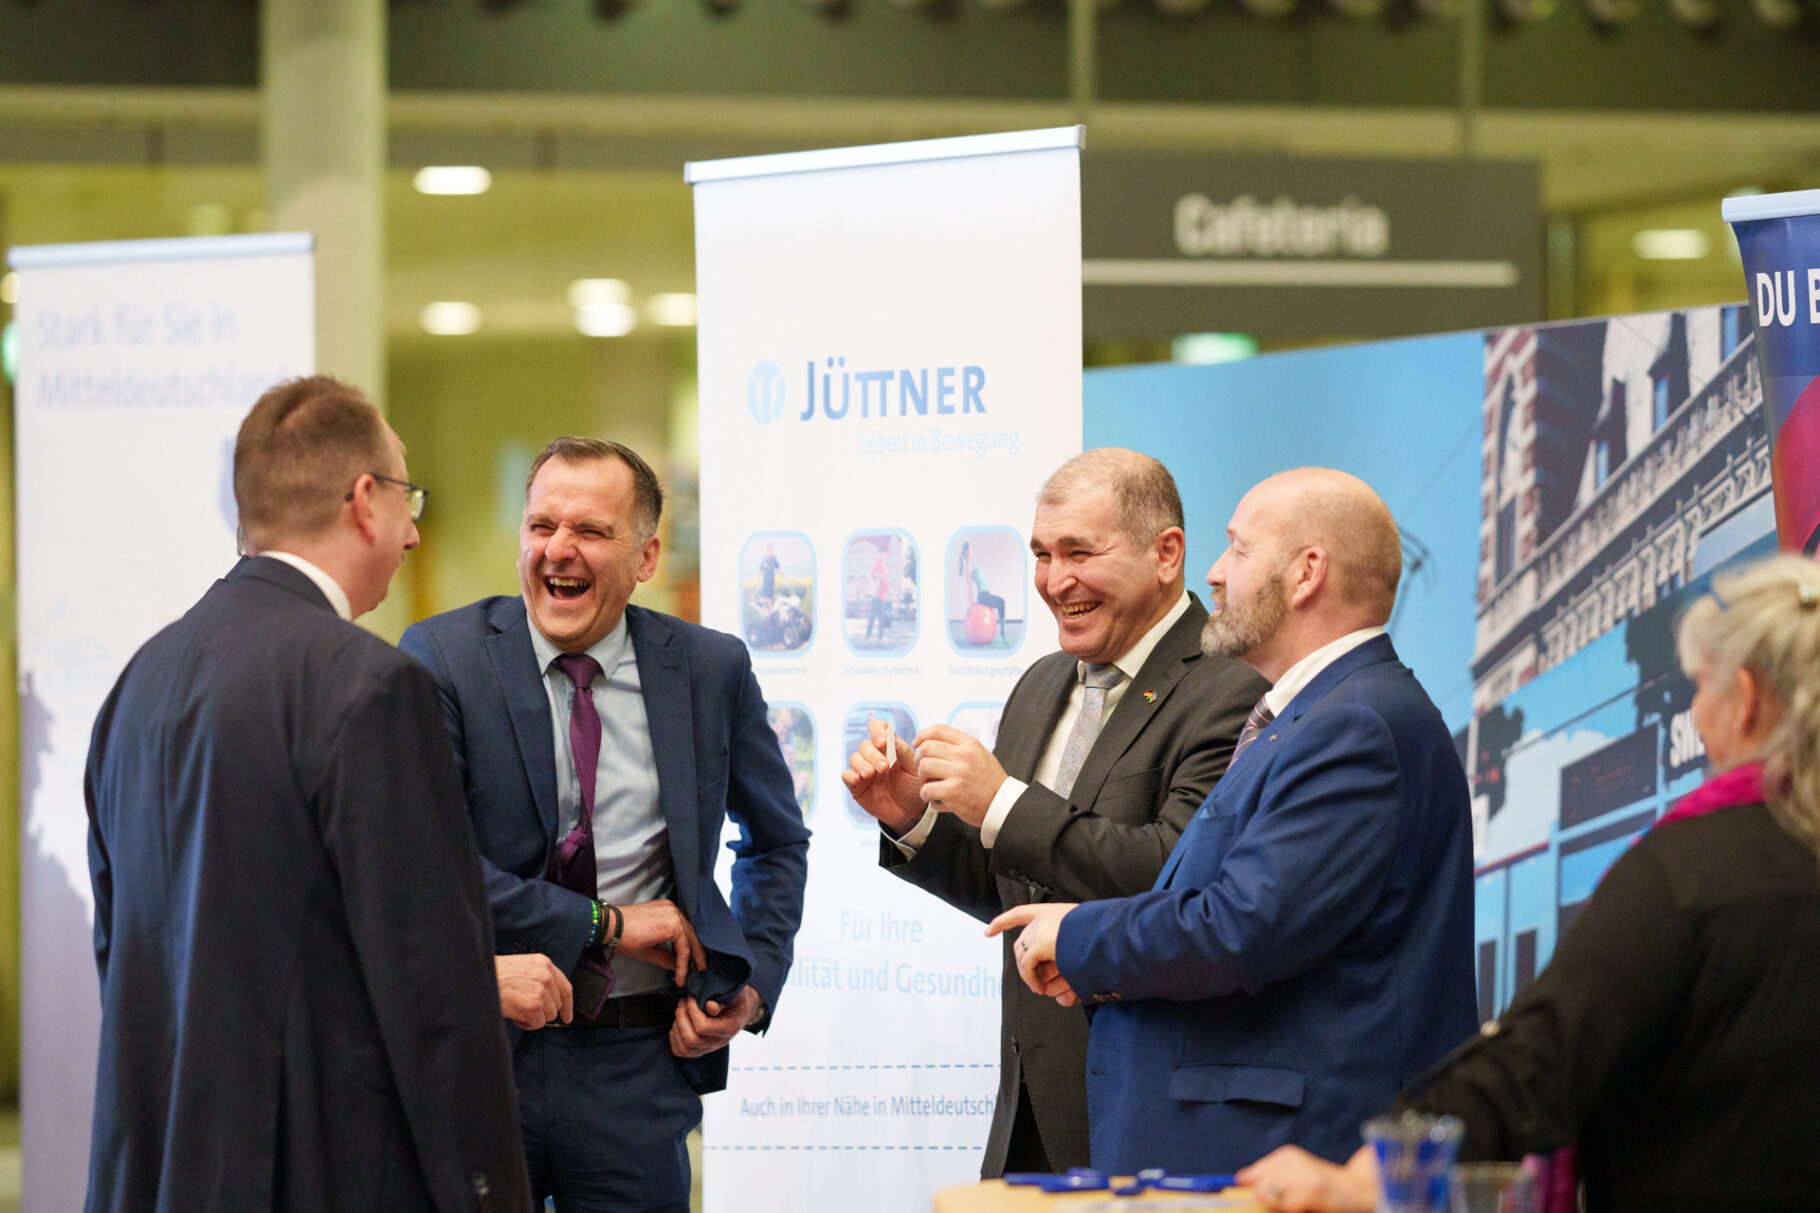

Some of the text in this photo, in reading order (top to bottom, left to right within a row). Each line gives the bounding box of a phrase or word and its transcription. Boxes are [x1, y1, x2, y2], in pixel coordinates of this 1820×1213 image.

[1174, 194, 1389, 257] Cafeteria
[1756, 270, 1796, 327] DU
[38, 301, 239, 350] Stark für Sie in
[38, 361, 289, 410] Mitteldeutschlan
[800, 355, 987, 422] JÜTTNER
[861, 429, 1019, 458] Leben in Bewegung
[840, 908, 923, 943] Für Ihre
[791, 955, 841, 989] ilität
[848, 960, 888, 991] und
[739, 1093, 997, 1117] Auch in Ihrer Nähe in Mitteldeutsch
